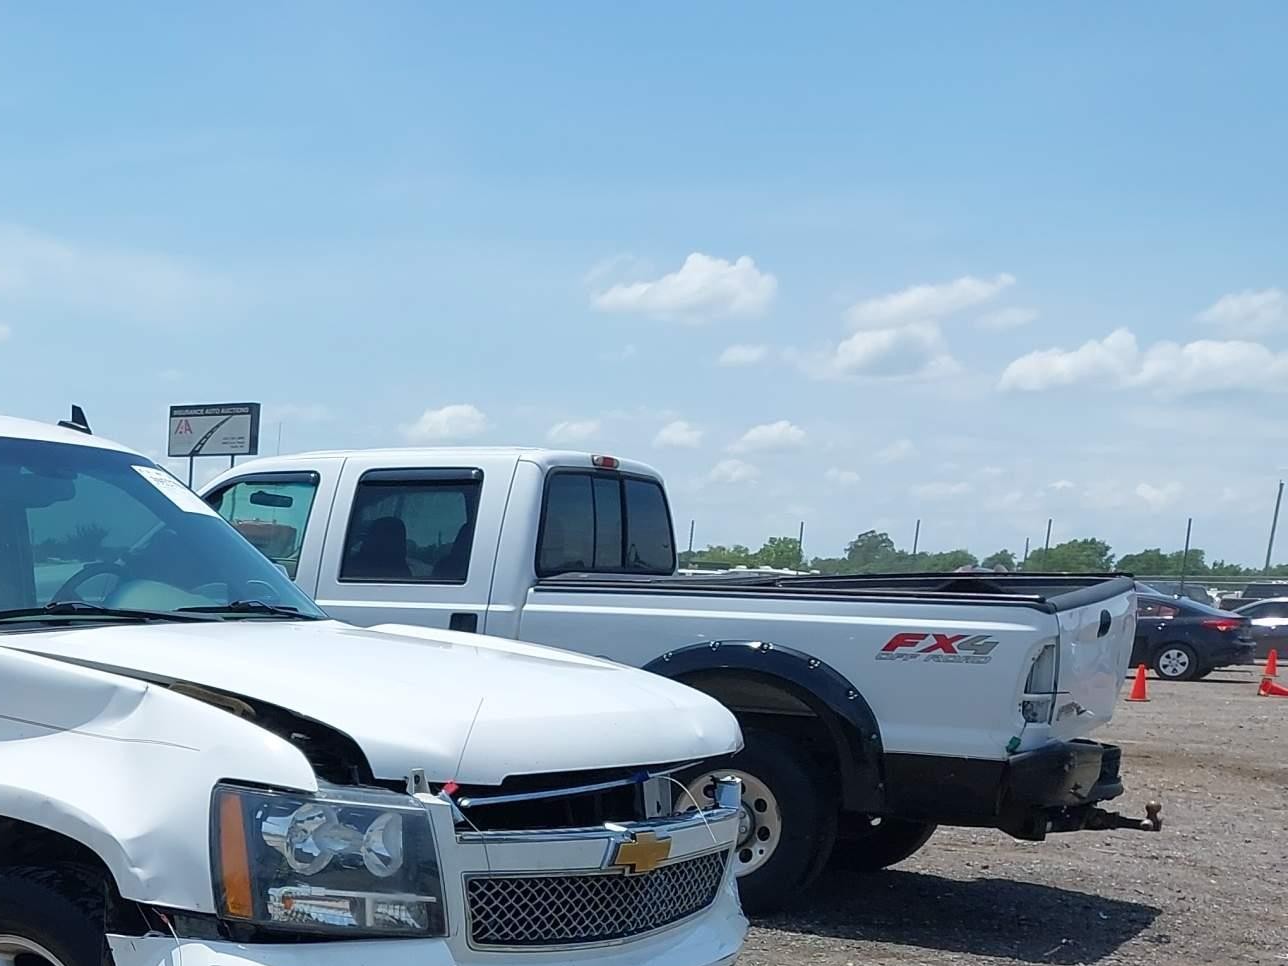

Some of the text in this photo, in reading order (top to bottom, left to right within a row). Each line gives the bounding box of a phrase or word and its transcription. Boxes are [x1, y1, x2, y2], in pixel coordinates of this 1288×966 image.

[880, 632, 1000, 656] FX4
[874, 652, 993, 665] OFF ROAD
